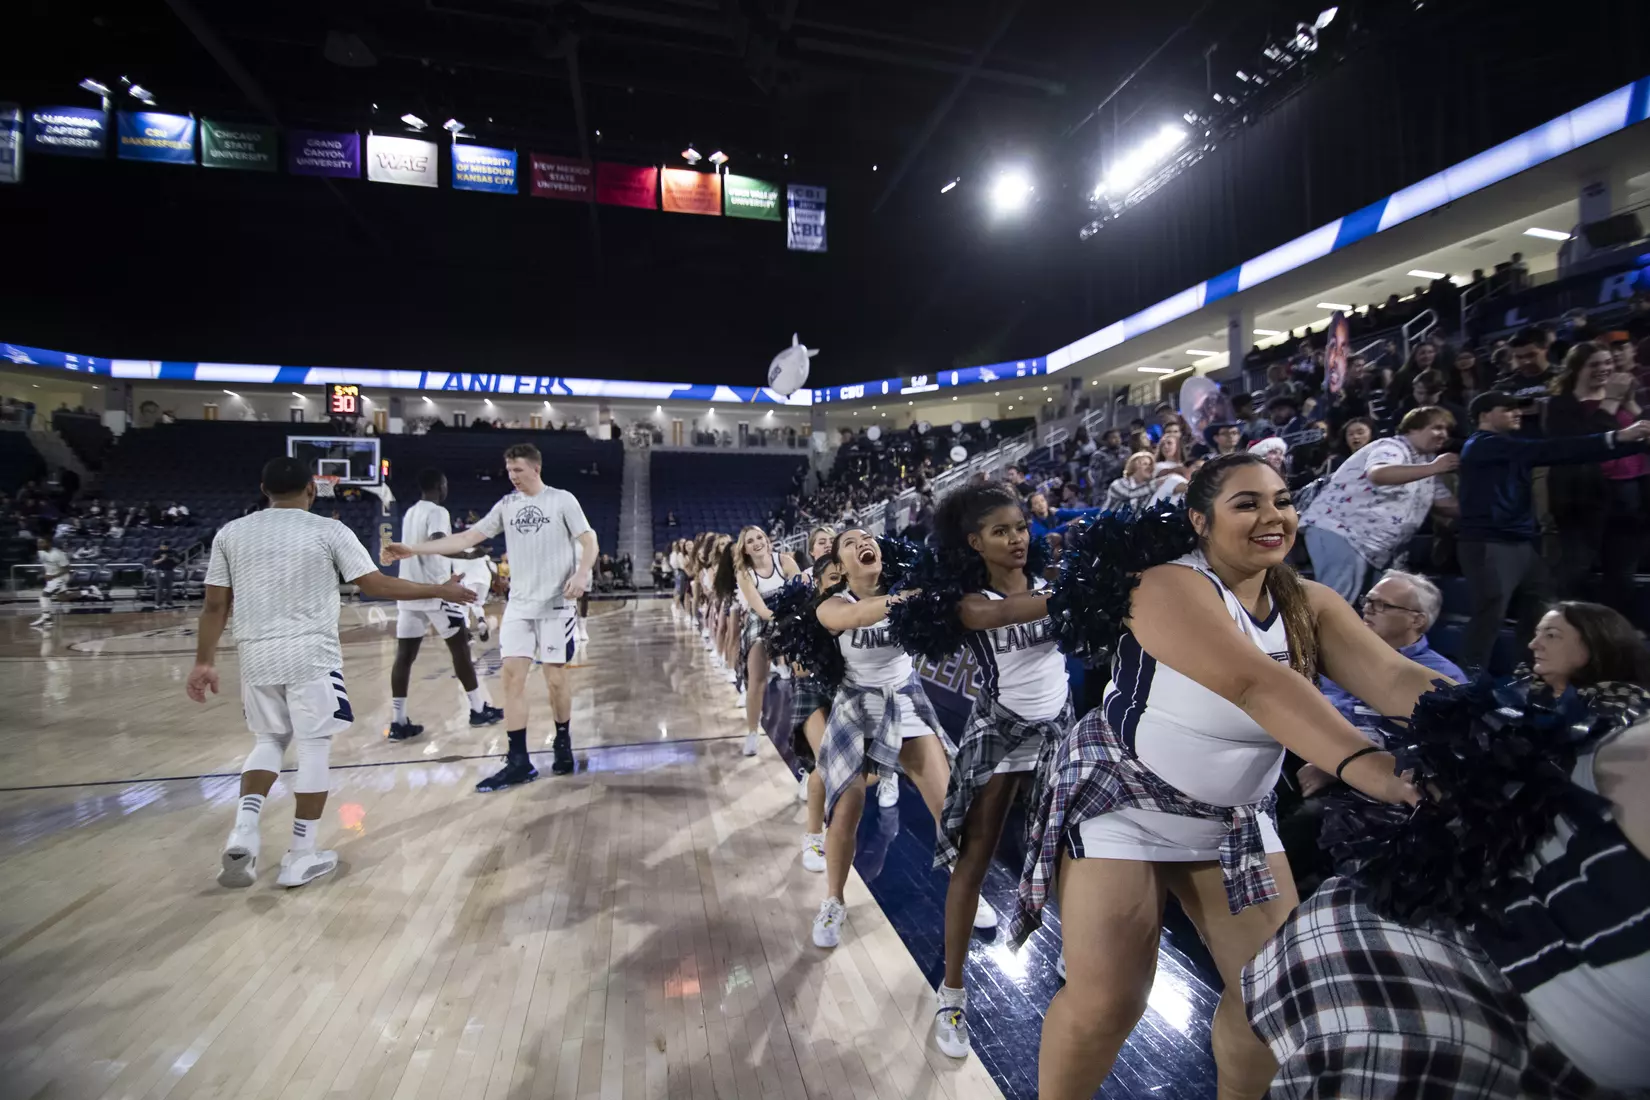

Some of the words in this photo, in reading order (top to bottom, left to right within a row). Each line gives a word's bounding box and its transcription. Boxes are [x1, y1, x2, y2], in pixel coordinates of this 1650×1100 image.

[35, 134, 101, 148] UNIVERSITY
[213, 130, 261, 141] CHICAGO
[224, 141, 255, 152] STATE
[306, 139, 342, 149] GRAND
[209, 149, 268, 161] UNIVERSITY
[303, 148, 345, 159] CANYON
[296, 157, 353, 168] UNIVERSITY
[376, 152, 429, 173] WAC
[534, 161, 555, 171] NEW
[556, 164, 590, 176] MEXICO
[456, 163, 469, 172] OF
[470, 164, 515, 177] MISSOURI
[456, 173, 493, 184] KANSAS
[494, 176, 515, 185] CITY
[549, 173, 575, 183] STATE
[537, 180, 587, 192] UNIVERSITY
[332, 395, 355, 413] 30
[510, 516, 551, 526] LANCERS
